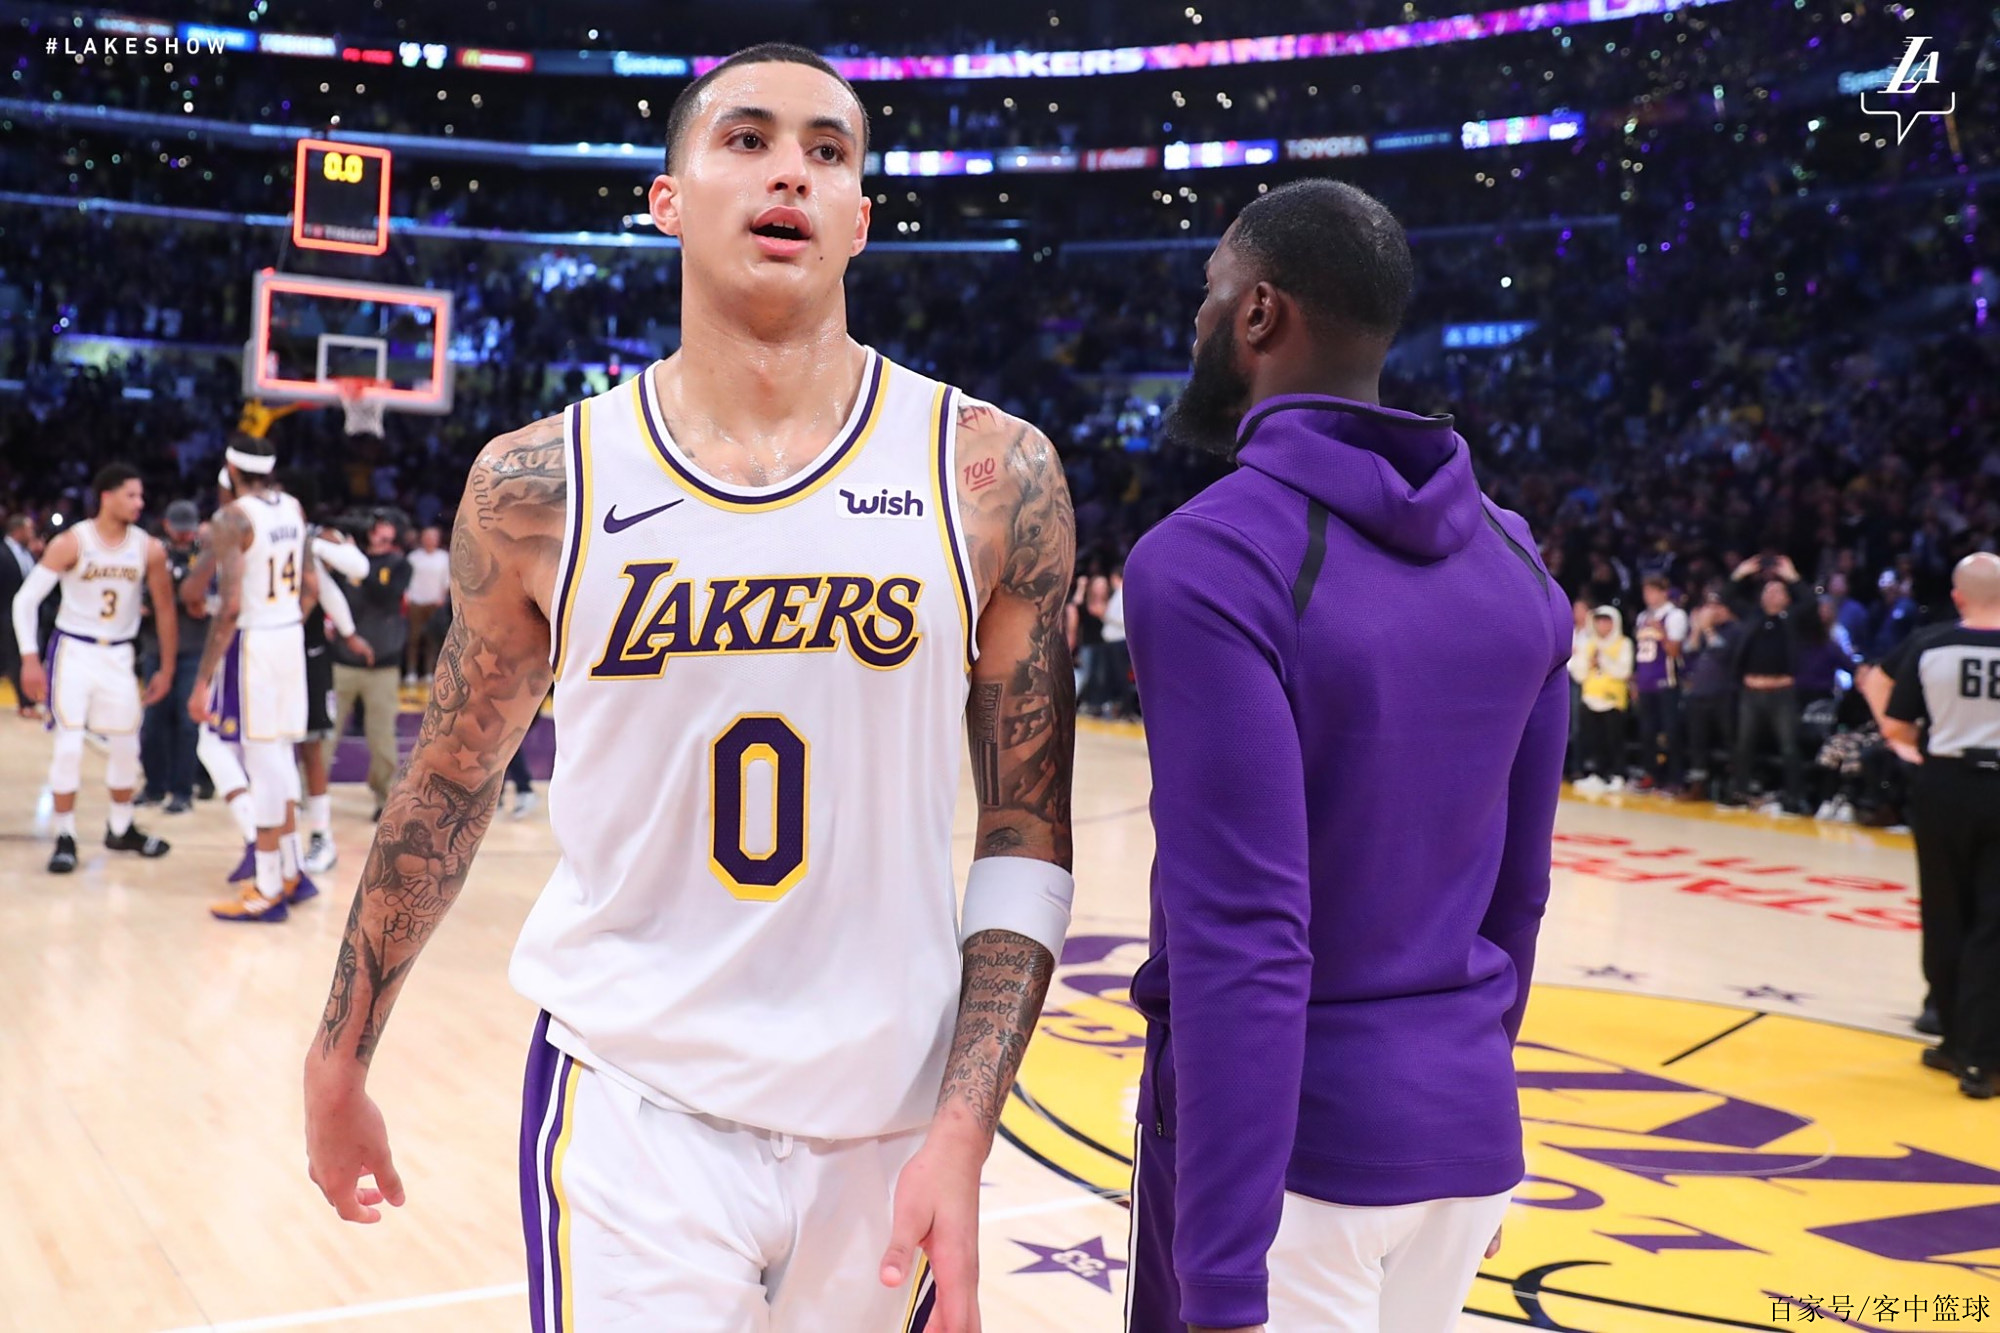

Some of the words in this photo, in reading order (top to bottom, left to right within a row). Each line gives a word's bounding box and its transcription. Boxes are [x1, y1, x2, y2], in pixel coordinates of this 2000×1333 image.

[952, 46, 1144, 79] LAKERS
[1285, 136, 1368, 160] TOYOTA
[324, 152, 363, 183] 0.0
[963, 457, 996, 487] 100
[840, 488, 925, 517] wish
[267, 550, 298, 603] 14
[100, 588, 117, 619] 3
[588, 558, 926, 681] LAKERS
[707, 711, 812, 902] 0
